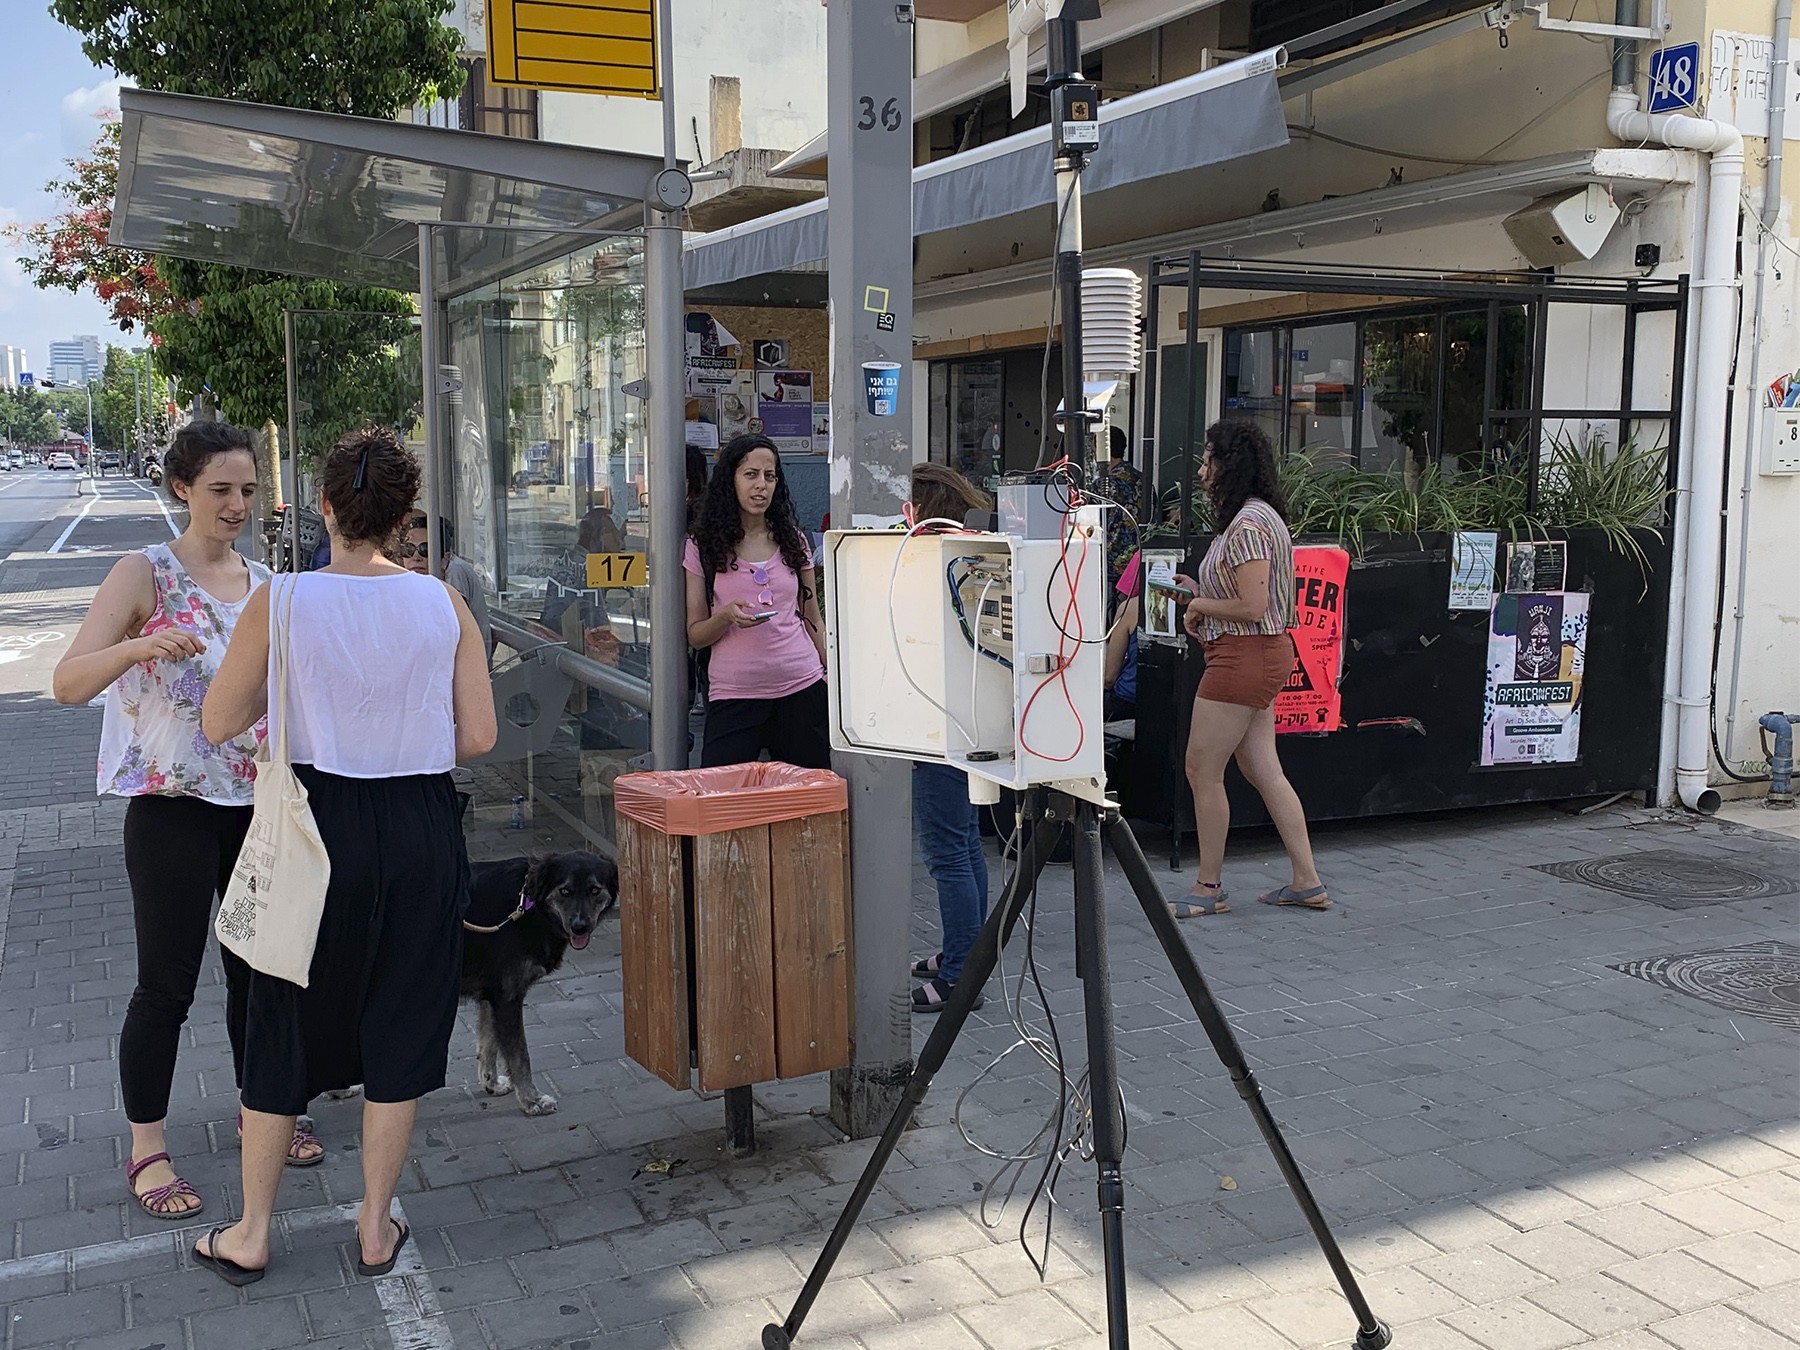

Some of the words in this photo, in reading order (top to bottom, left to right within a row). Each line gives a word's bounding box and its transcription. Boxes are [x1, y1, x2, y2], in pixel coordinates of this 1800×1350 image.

[1655, 56, 1692, 100] 48
[857, 95, 902, 132] 36
[870, 377, 884, 386] אני
[886, 377, 897, 386] גם
[868, 386, 894, 397] שותף!
[1791, 426, 1798, 441] 8
[601, 555, 635, 581] 17
[1295, 564, 1325, 576] ATIVE
[1295, 576, 1340, 614] TER
[1497, 686, 1571, 702] AFRICANFEST
